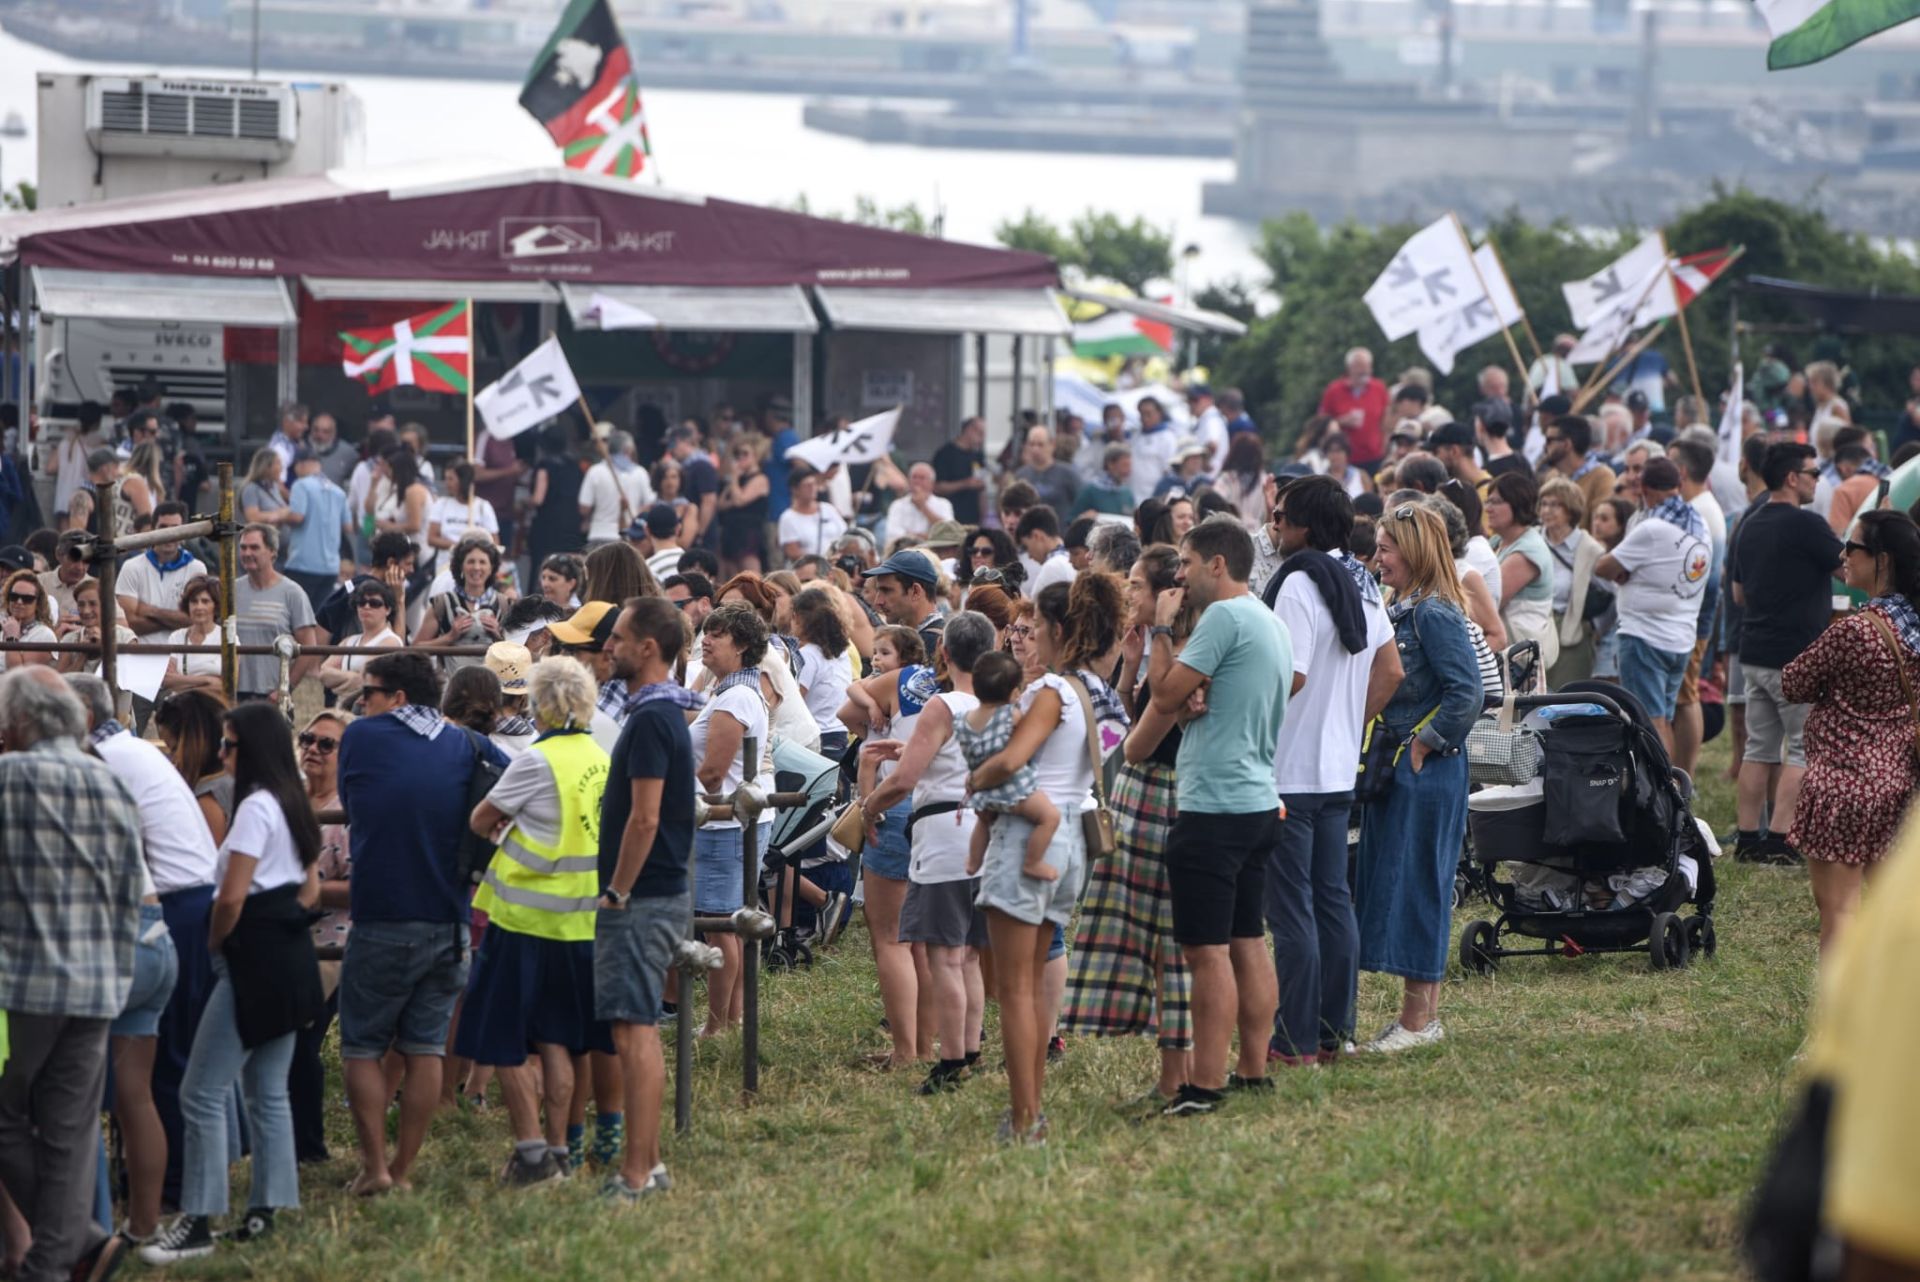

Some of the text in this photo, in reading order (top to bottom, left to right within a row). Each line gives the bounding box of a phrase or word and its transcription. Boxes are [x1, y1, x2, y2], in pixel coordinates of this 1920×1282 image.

[162, 81, 268, 96] THERMO KING
[155, 332, 212, 348] IVECO
